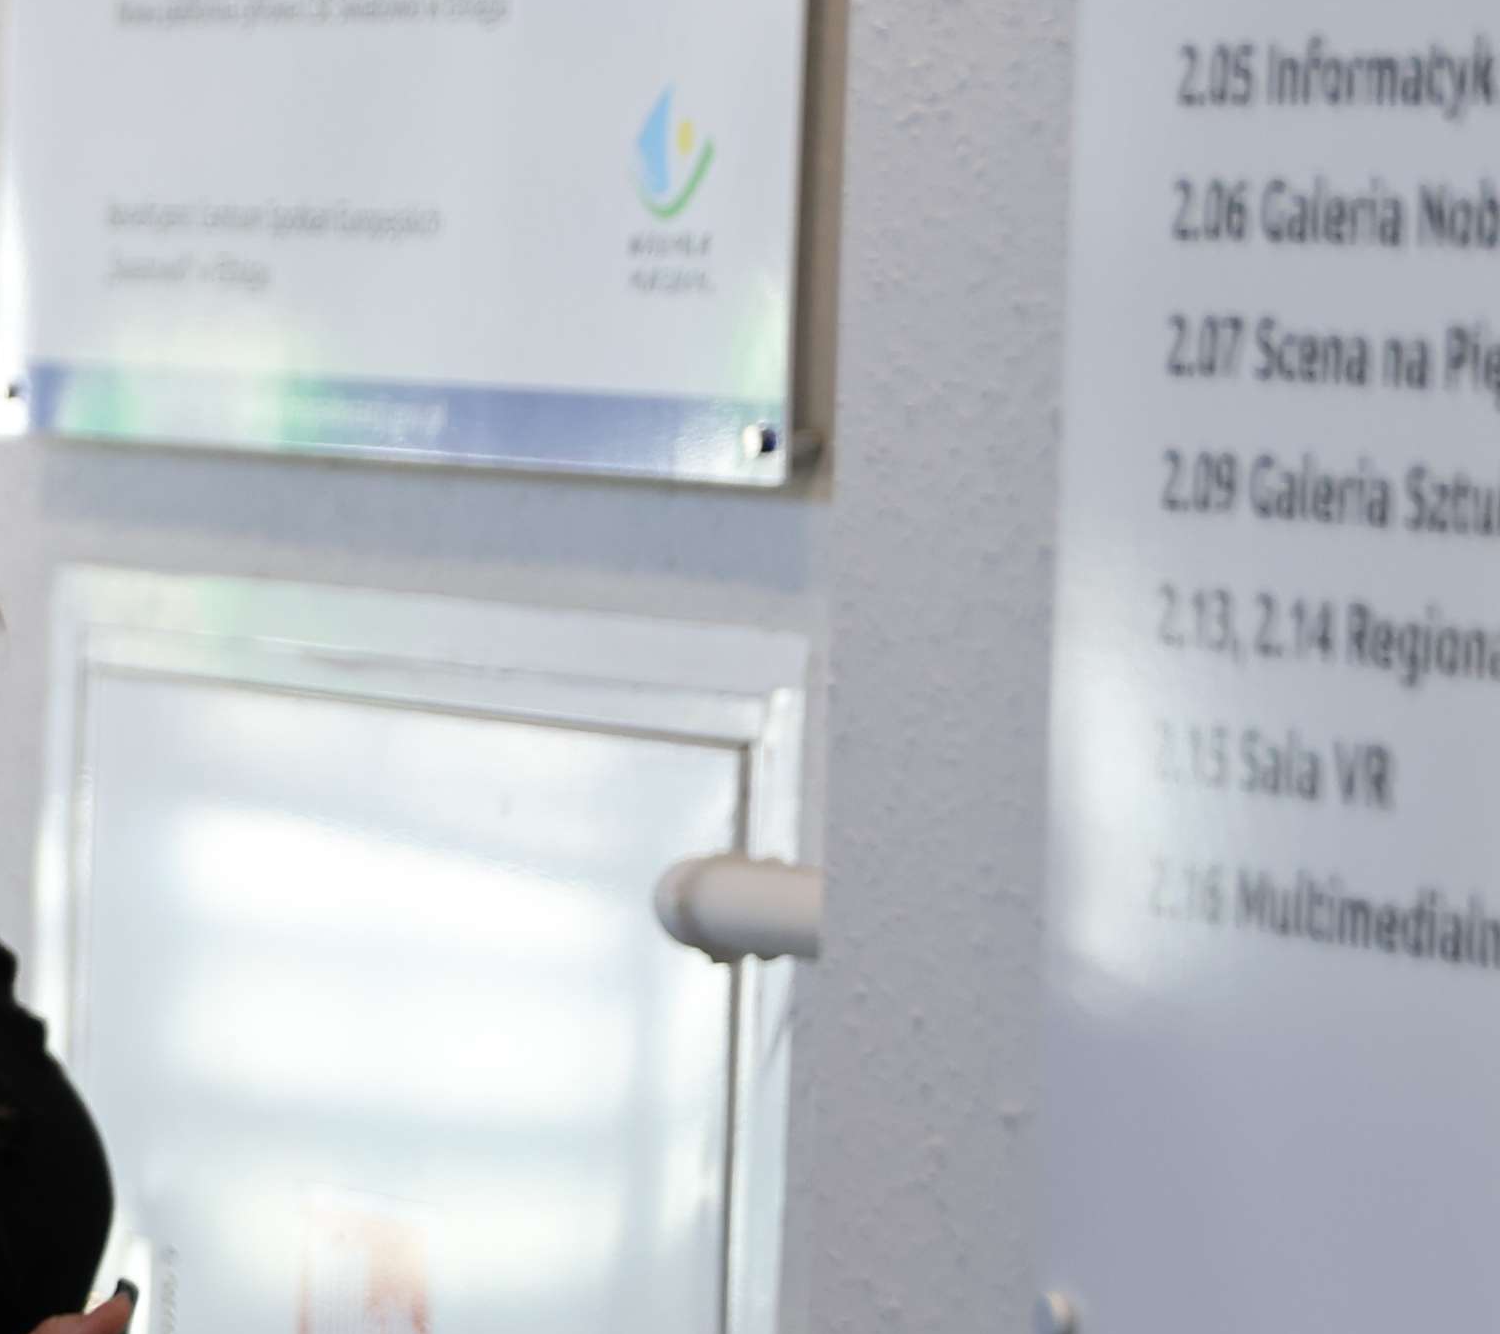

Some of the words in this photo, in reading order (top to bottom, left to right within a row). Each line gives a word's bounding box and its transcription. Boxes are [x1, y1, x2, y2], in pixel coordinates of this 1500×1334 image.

[1176, 41, 1256, 108] 2.05
[1264, 32, 1495, 122] Informatyk
[1170, 177, 1250, 245] 2.06
[1258, 174, 1403, 249] Galeria
[1165, 313, 1245, 380] 2.07
[1252, 314, 1370, 387] Scena
[1380, 335, 1430, 391] na
[1160, 448, 1238, 516] 2.09
[1247, 451, 1391, 530] Galeria
[1402, 463, 1500, 537] Sztu
[1238, 725, 1322, 803] Sala
[1331, 737, 1395, 812] VR
